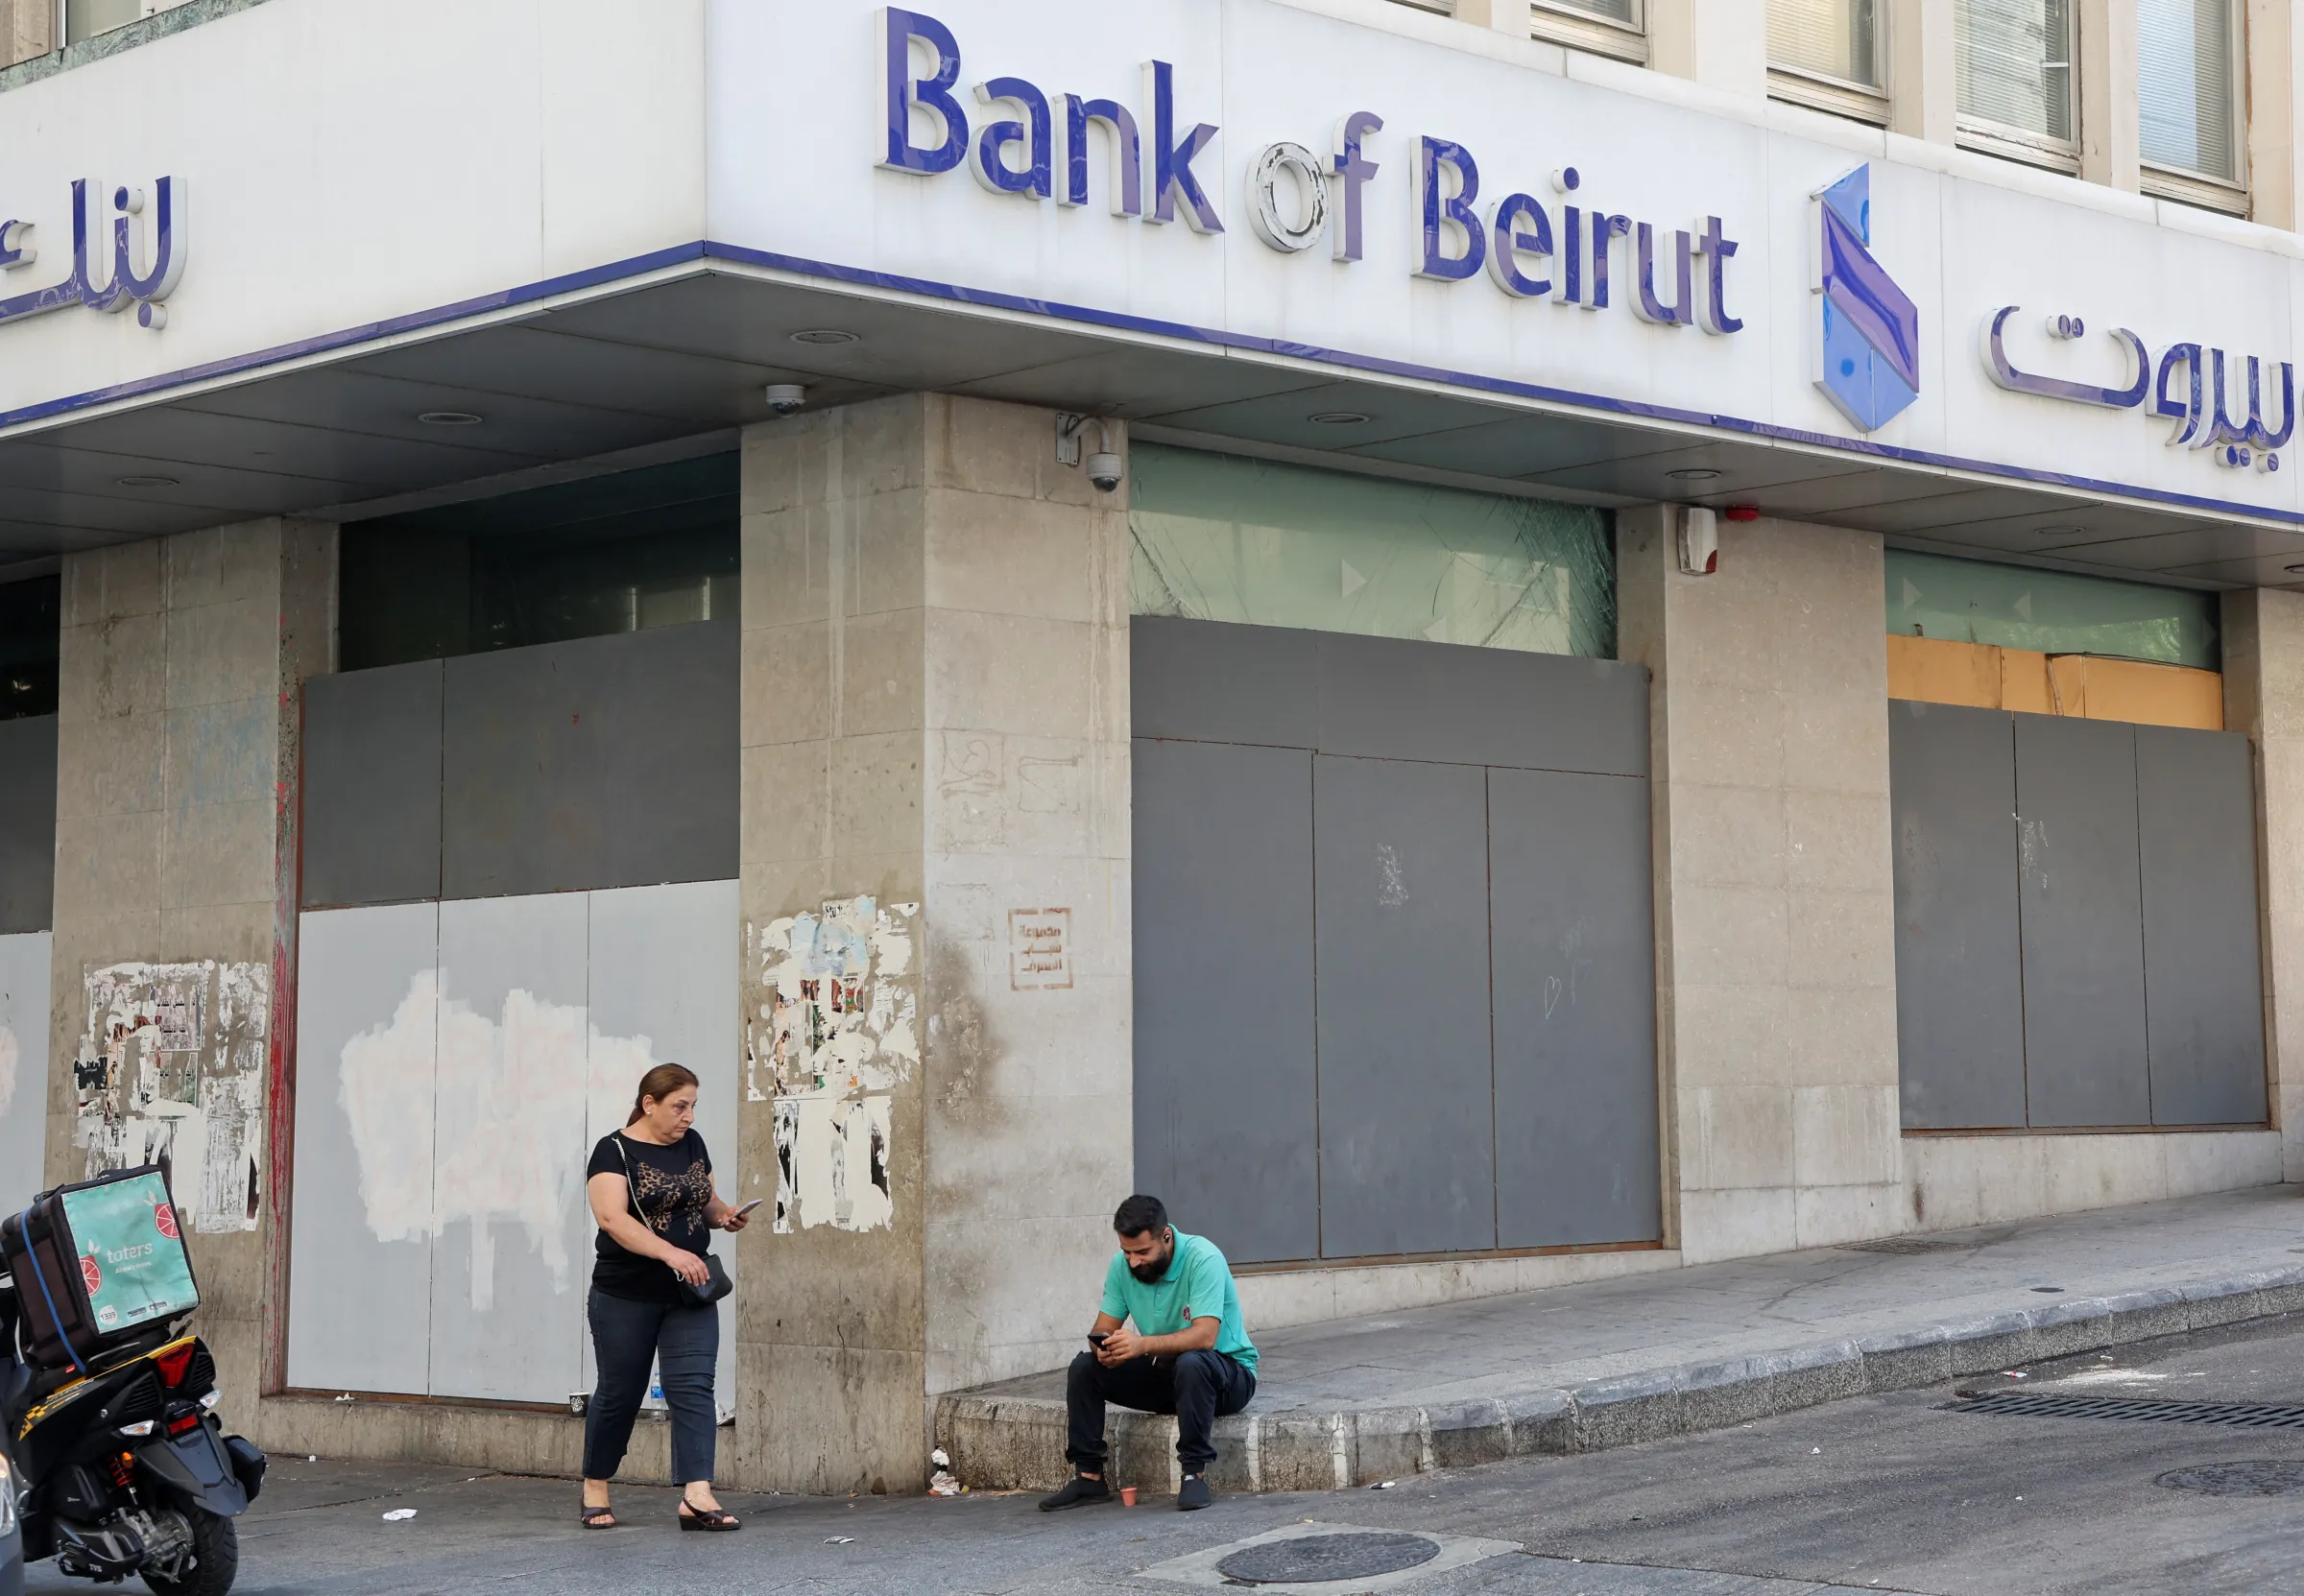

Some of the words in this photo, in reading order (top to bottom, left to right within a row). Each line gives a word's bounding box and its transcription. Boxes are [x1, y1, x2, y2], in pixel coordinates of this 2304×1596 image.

[875, 6, 1224, 236] Bank
[1245, 110, 1384, 264] of
[1410, 135, 1743, 337] Beirut
[1979, 305, 2294, 473] بيروت
[107, 1243, 153, 1264] toters
[101, 1311, 116, 1321] 1339
[88, 1563, 103, 1572] TVS
